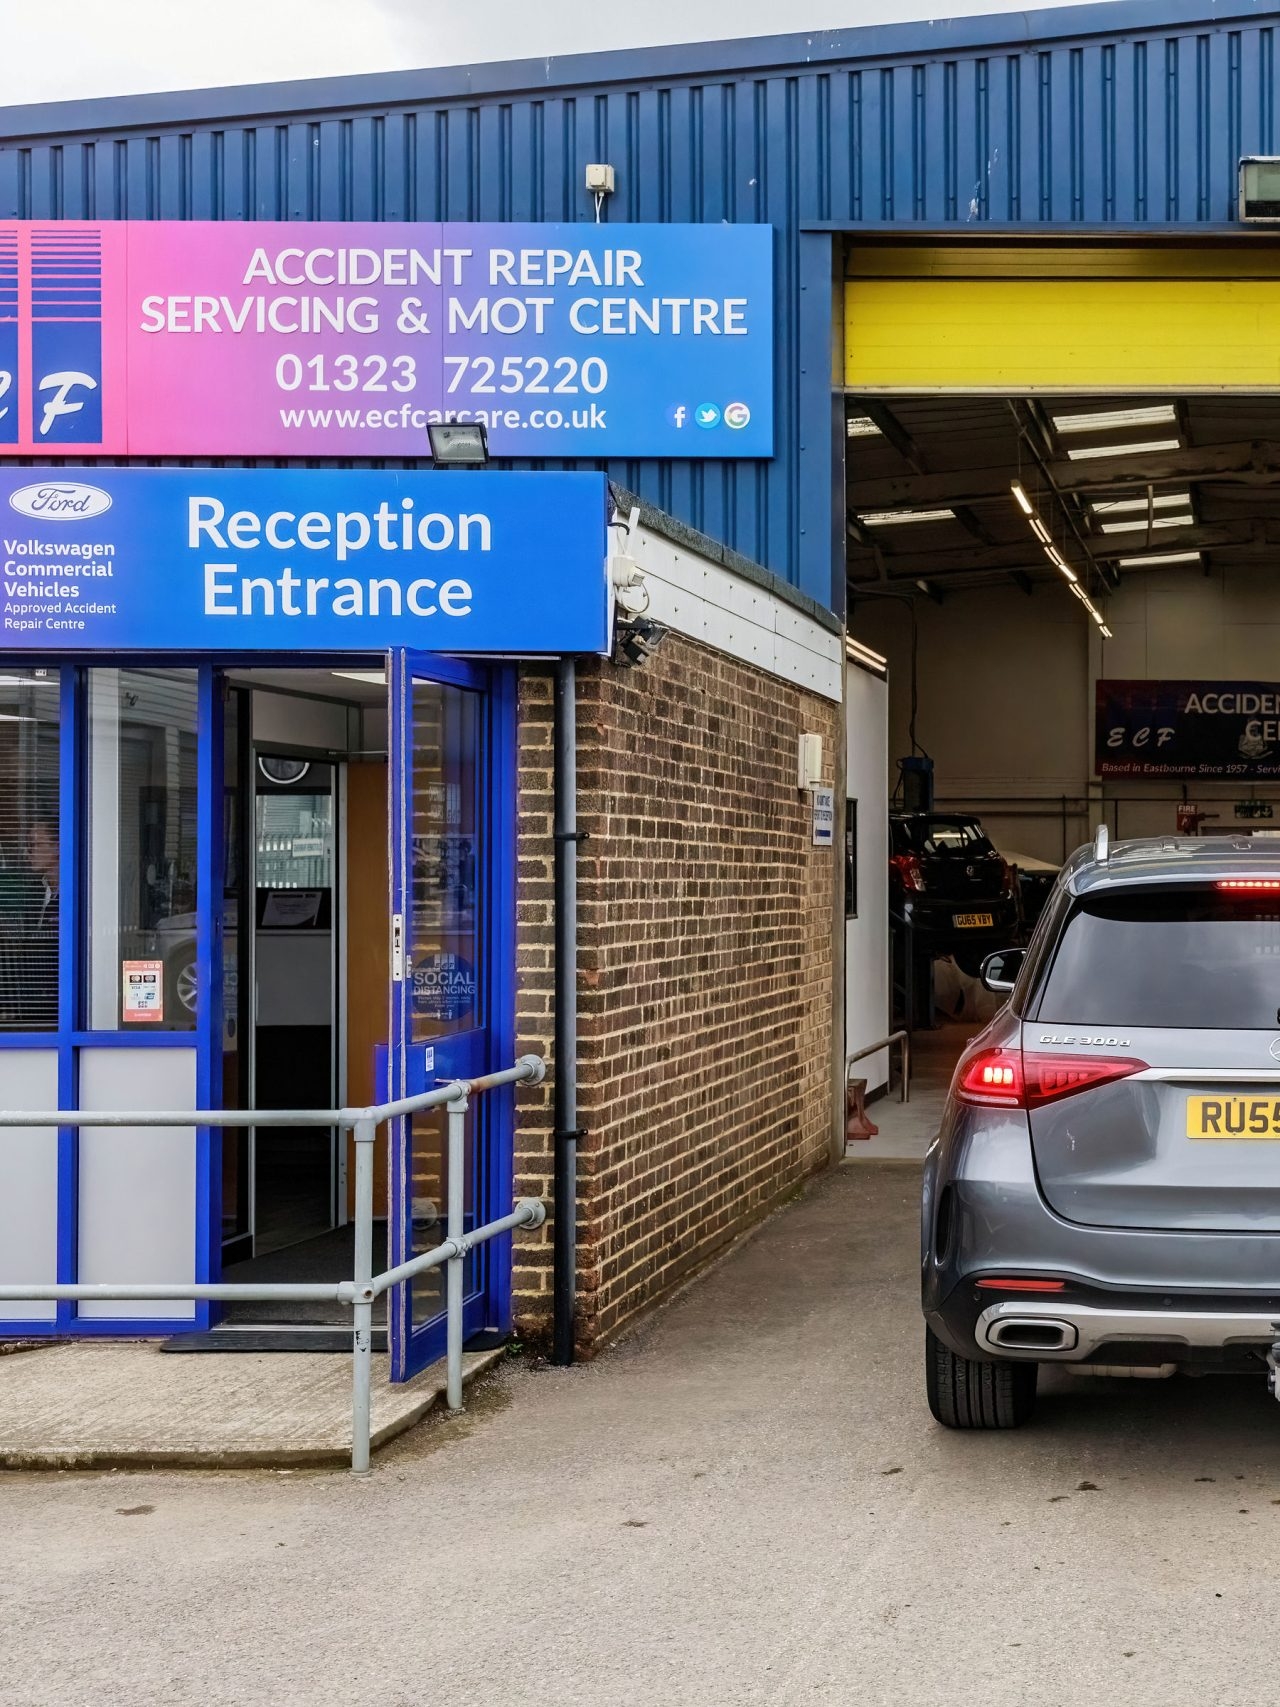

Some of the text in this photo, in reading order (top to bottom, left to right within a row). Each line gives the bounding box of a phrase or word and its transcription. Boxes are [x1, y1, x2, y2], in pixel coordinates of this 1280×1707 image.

[242, 248, 644, 287] ACCIDENT REPAIR
[140, 296, 749, 335] SERVICING & MOT CENTRE
[275, 354, 609, 394] 01323 725220
[279, 403, 607, 429] www.ecfcarcare.co.uk
[31, 487, 91, 512] Ford
[188, 496, 492, 560] Reception
[3, 539, 115, 559] Volkswagen
[4, 561, 113, 577] Commercial
[3, 581, 80, 598] Vehicles
[203, 563, 473, 617] Entrance
[4, 602, 117, 615] Approved Accident
[4, 618, 86, 631] Repair Centre
[1102, 762, 1130, 773] Based
[1132, 762, 1141, 773] in
[1143, 762, 1196, 774] Eastbourne
[1199, 763, 1222, 774] Since
[1226, 763, 1248, 774] 1957
[1178, 805, 1196, 813] FIRE
[413, 971, 476, 985] SOCIAL
[413, 985, 476, 995] DISTANCING
[1040, 1035, 1076, 1045] GLE
